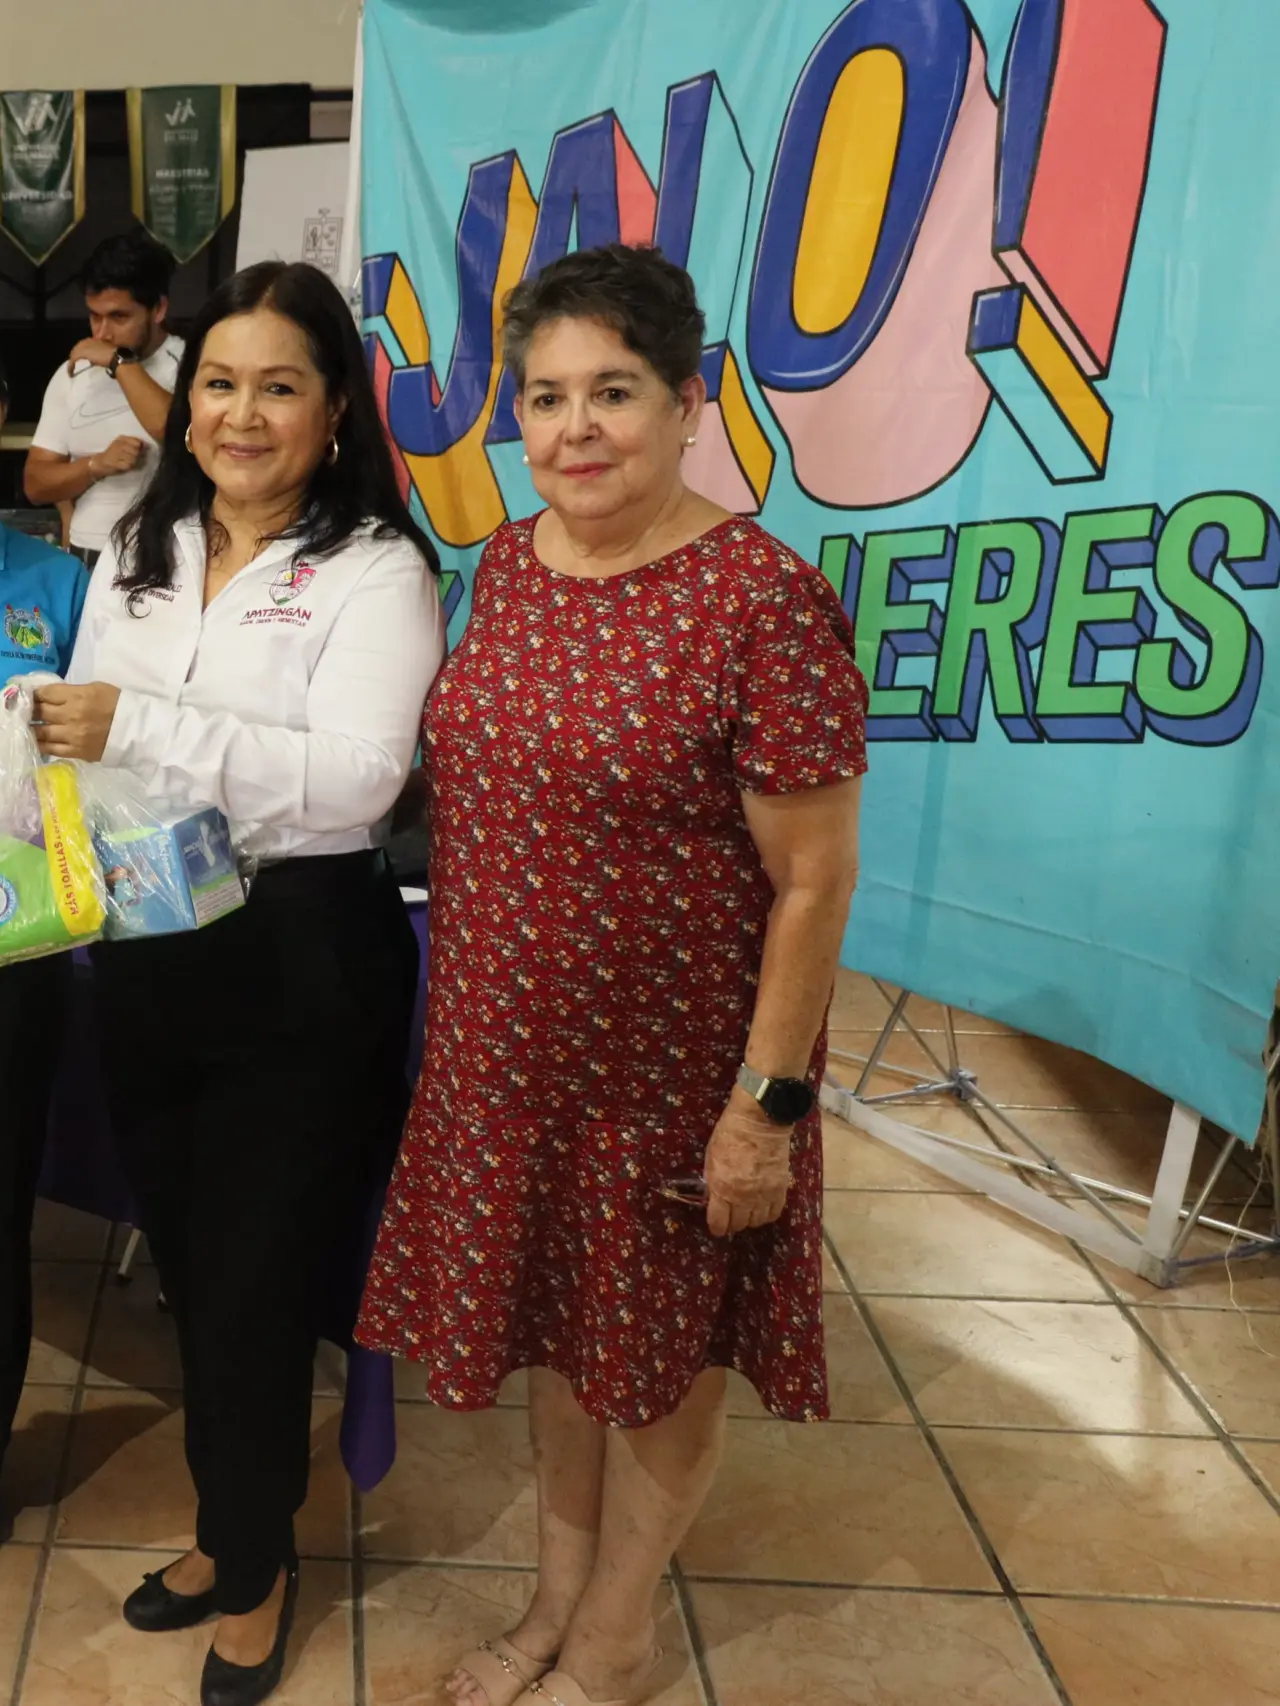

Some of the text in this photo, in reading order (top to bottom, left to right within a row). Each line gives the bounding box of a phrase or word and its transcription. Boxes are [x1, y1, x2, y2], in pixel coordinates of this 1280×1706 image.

[242, 606, 312, 621] APATZINGÁN
[818, 489, 1280, 747] ERES
[53, 841, 73, 889] TOALLAS
